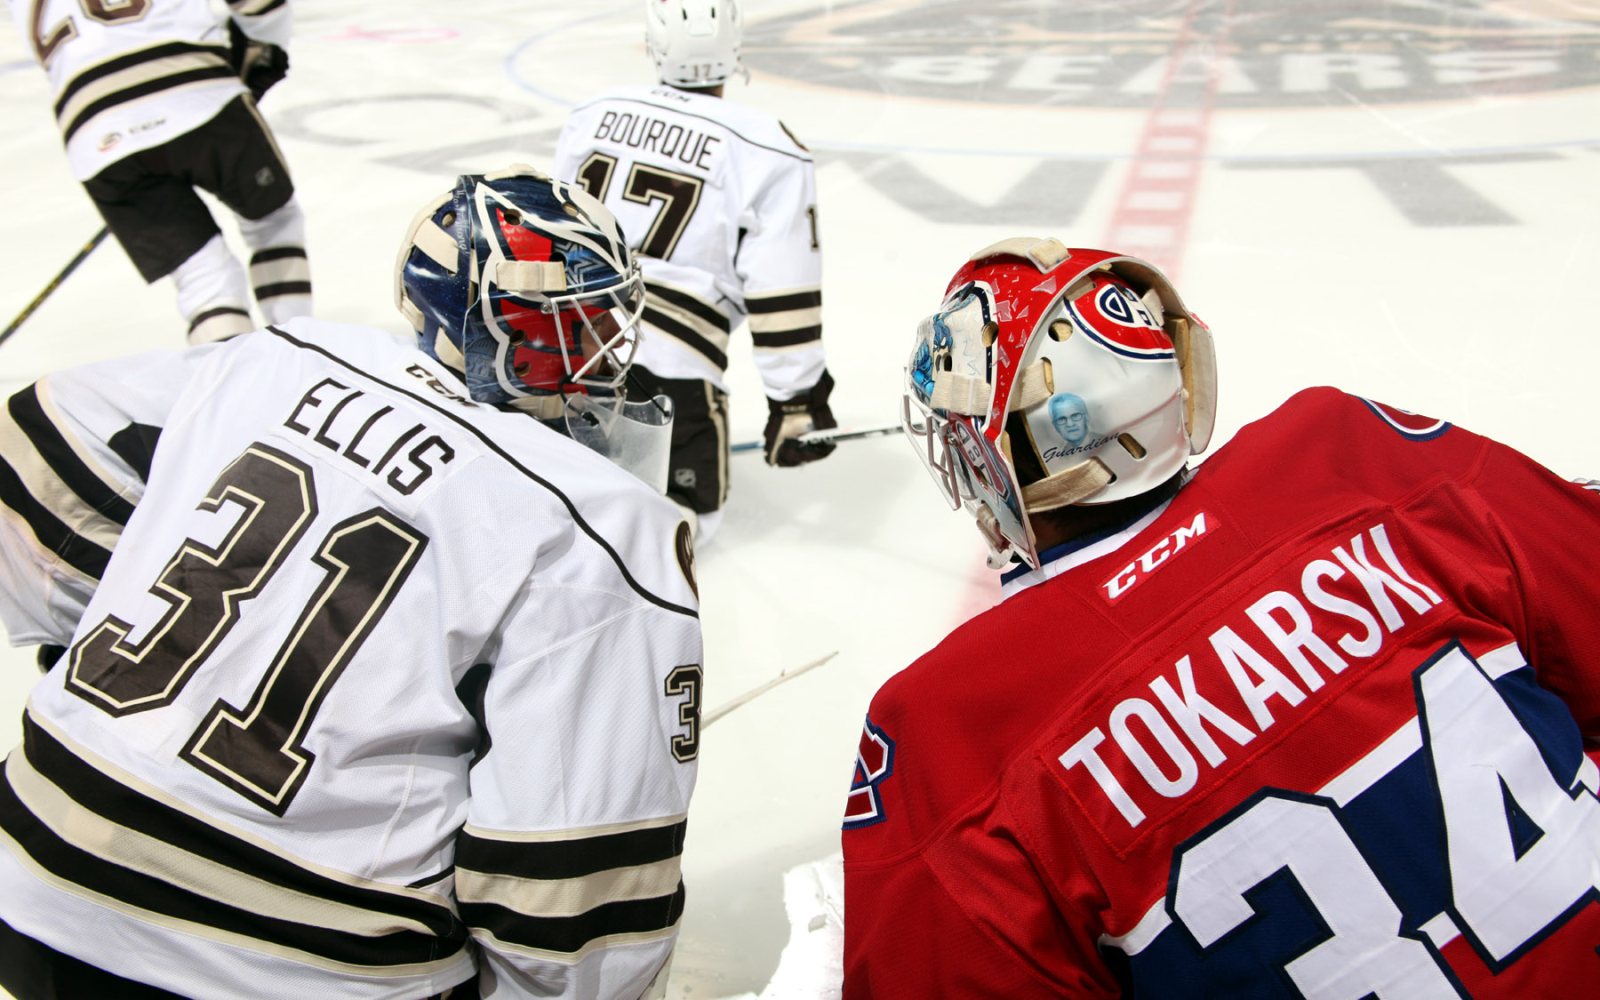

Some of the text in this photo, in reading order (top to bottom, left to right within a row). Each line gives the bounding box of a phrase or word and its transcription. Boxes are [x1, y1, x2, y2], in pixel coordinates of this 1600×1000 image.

[692, 63, 712, 78] 17
[885, 50, 1562, 94] BEARS
[594, 111, 721, 171] BOURQUE
[575, 151, 705, 262] 17
[283, 377, 455, 495] ELLIS
[1043, 432, 1120, 463] Guardian
[1101, 512, 1208, 600] CCM
[64, 441, 430, 817] 31
[1058, 522, 1444, 828] TOKARSKI
[1164, 637, 1600, 1000] 34
